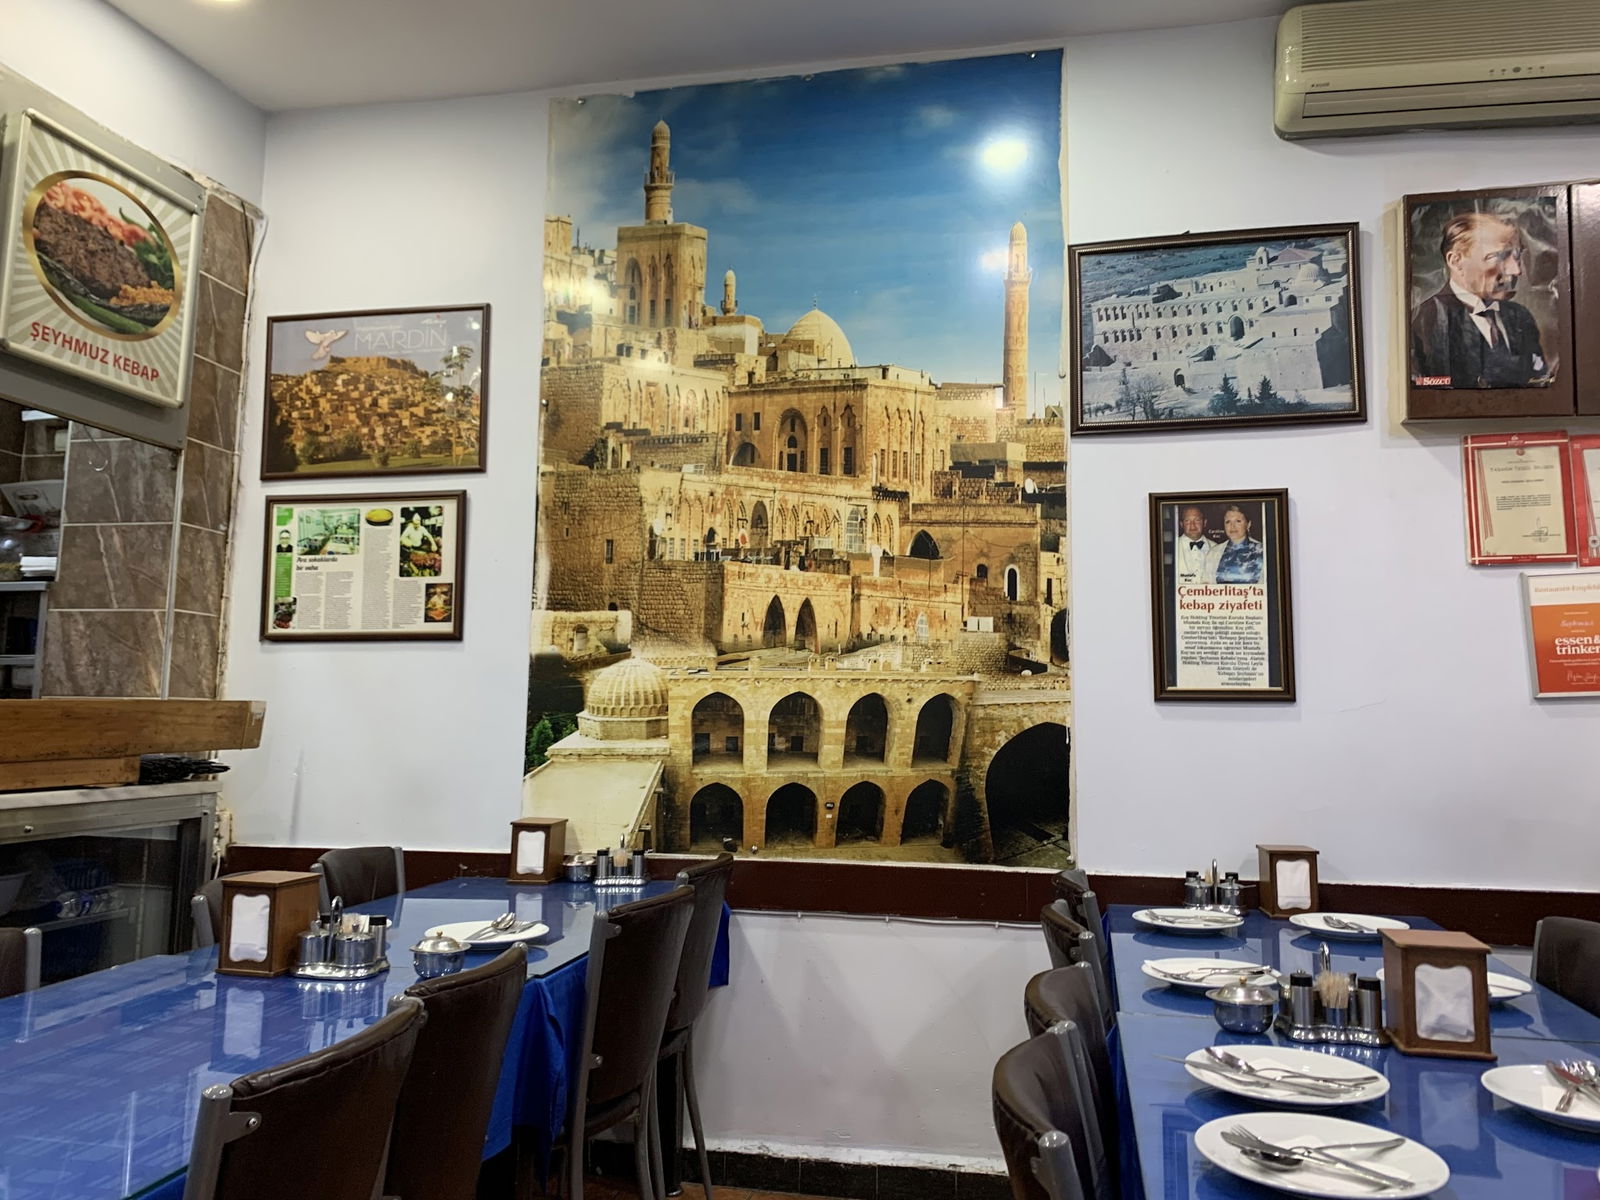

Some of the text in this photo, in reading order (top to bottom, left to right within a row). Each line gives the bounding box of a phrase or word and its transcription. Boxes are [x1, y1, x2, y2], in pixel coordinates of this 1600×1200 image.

[30, 322, 159, 381] ŞEYHMUZ KEBAP
[1177, 585, 1264, 599] Çemberlitaş'ta
[1179, 600, 1262, 613] kebap ziyafeti
